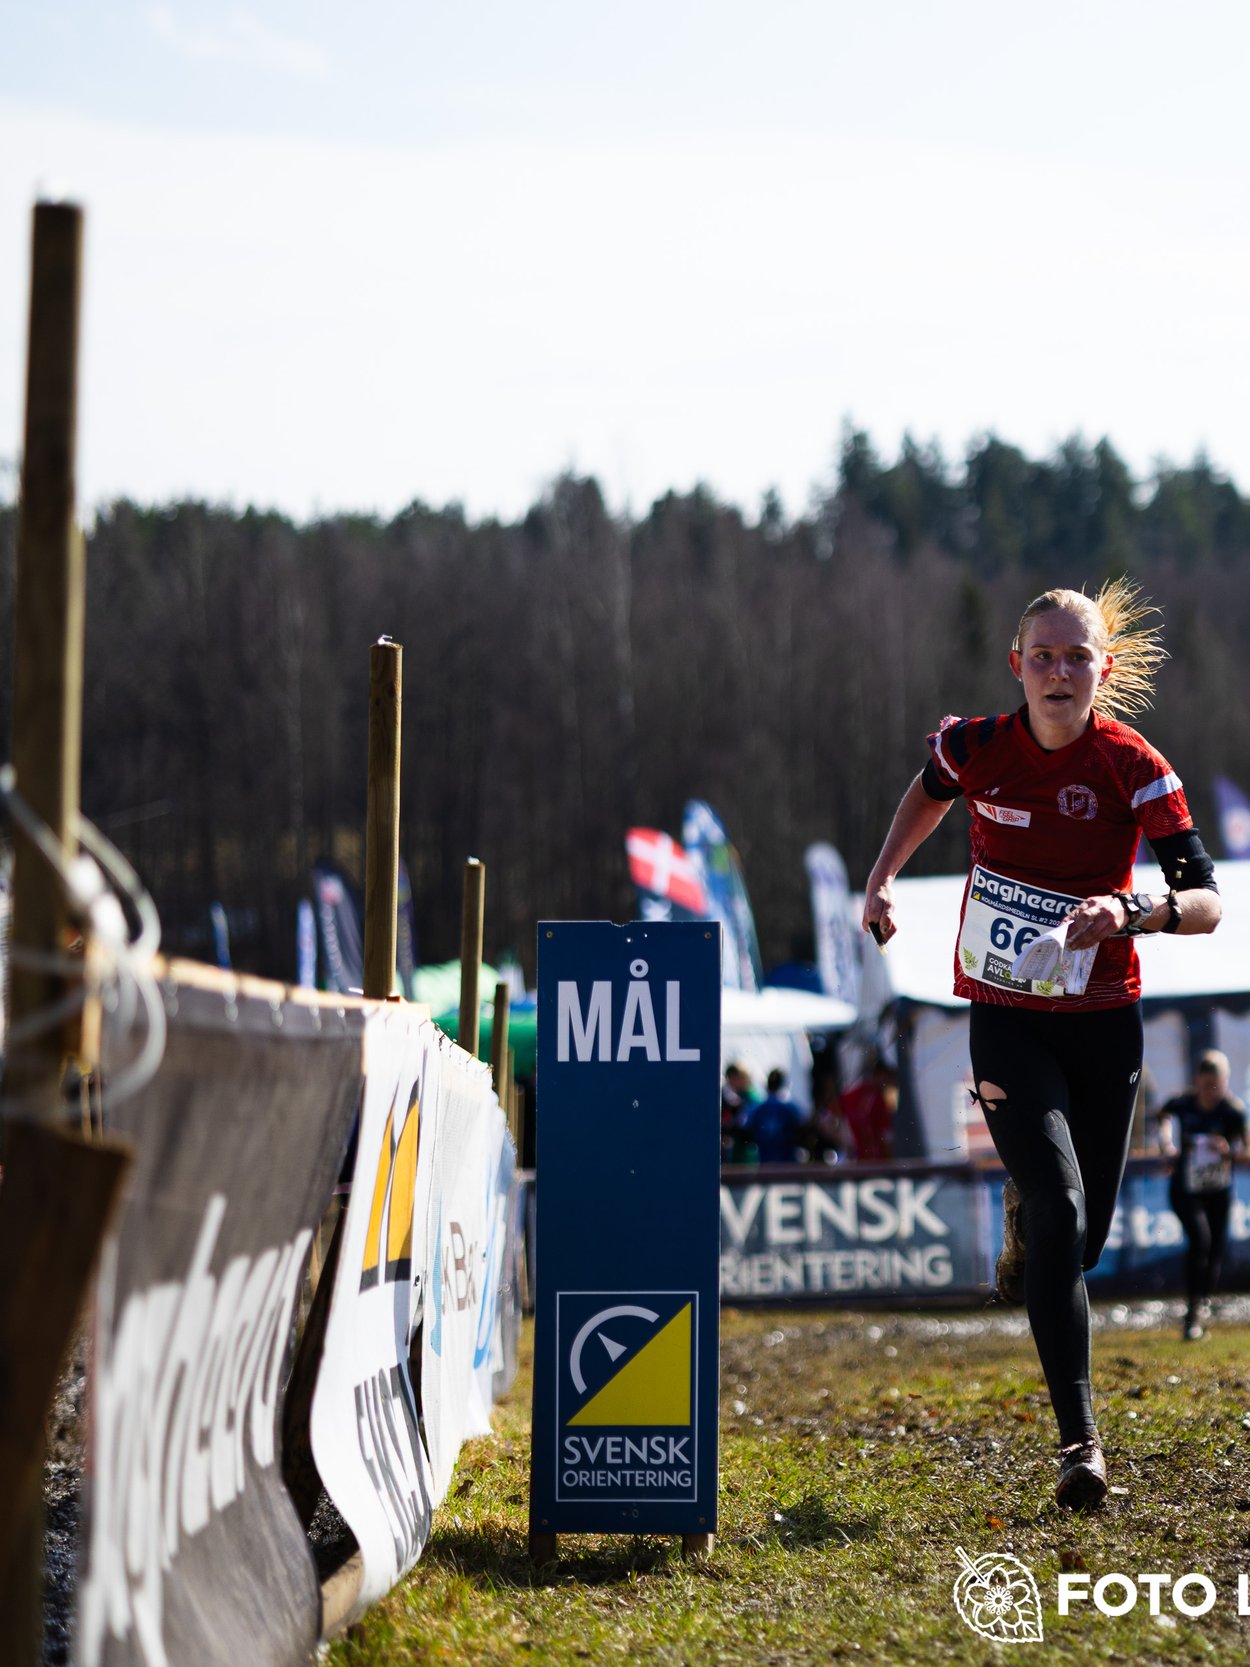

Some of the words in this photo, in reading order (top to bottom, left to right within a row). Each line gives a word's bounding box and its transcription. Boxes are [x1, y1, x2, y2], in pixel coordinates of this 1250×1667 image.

[1031, 914, 1039, 922] SL
[557, 958, 701, 1062] MÅL
[563, 1436, 691, 1465] SVENSK
[562, 1470, 692, 1488] ORIENTERING
